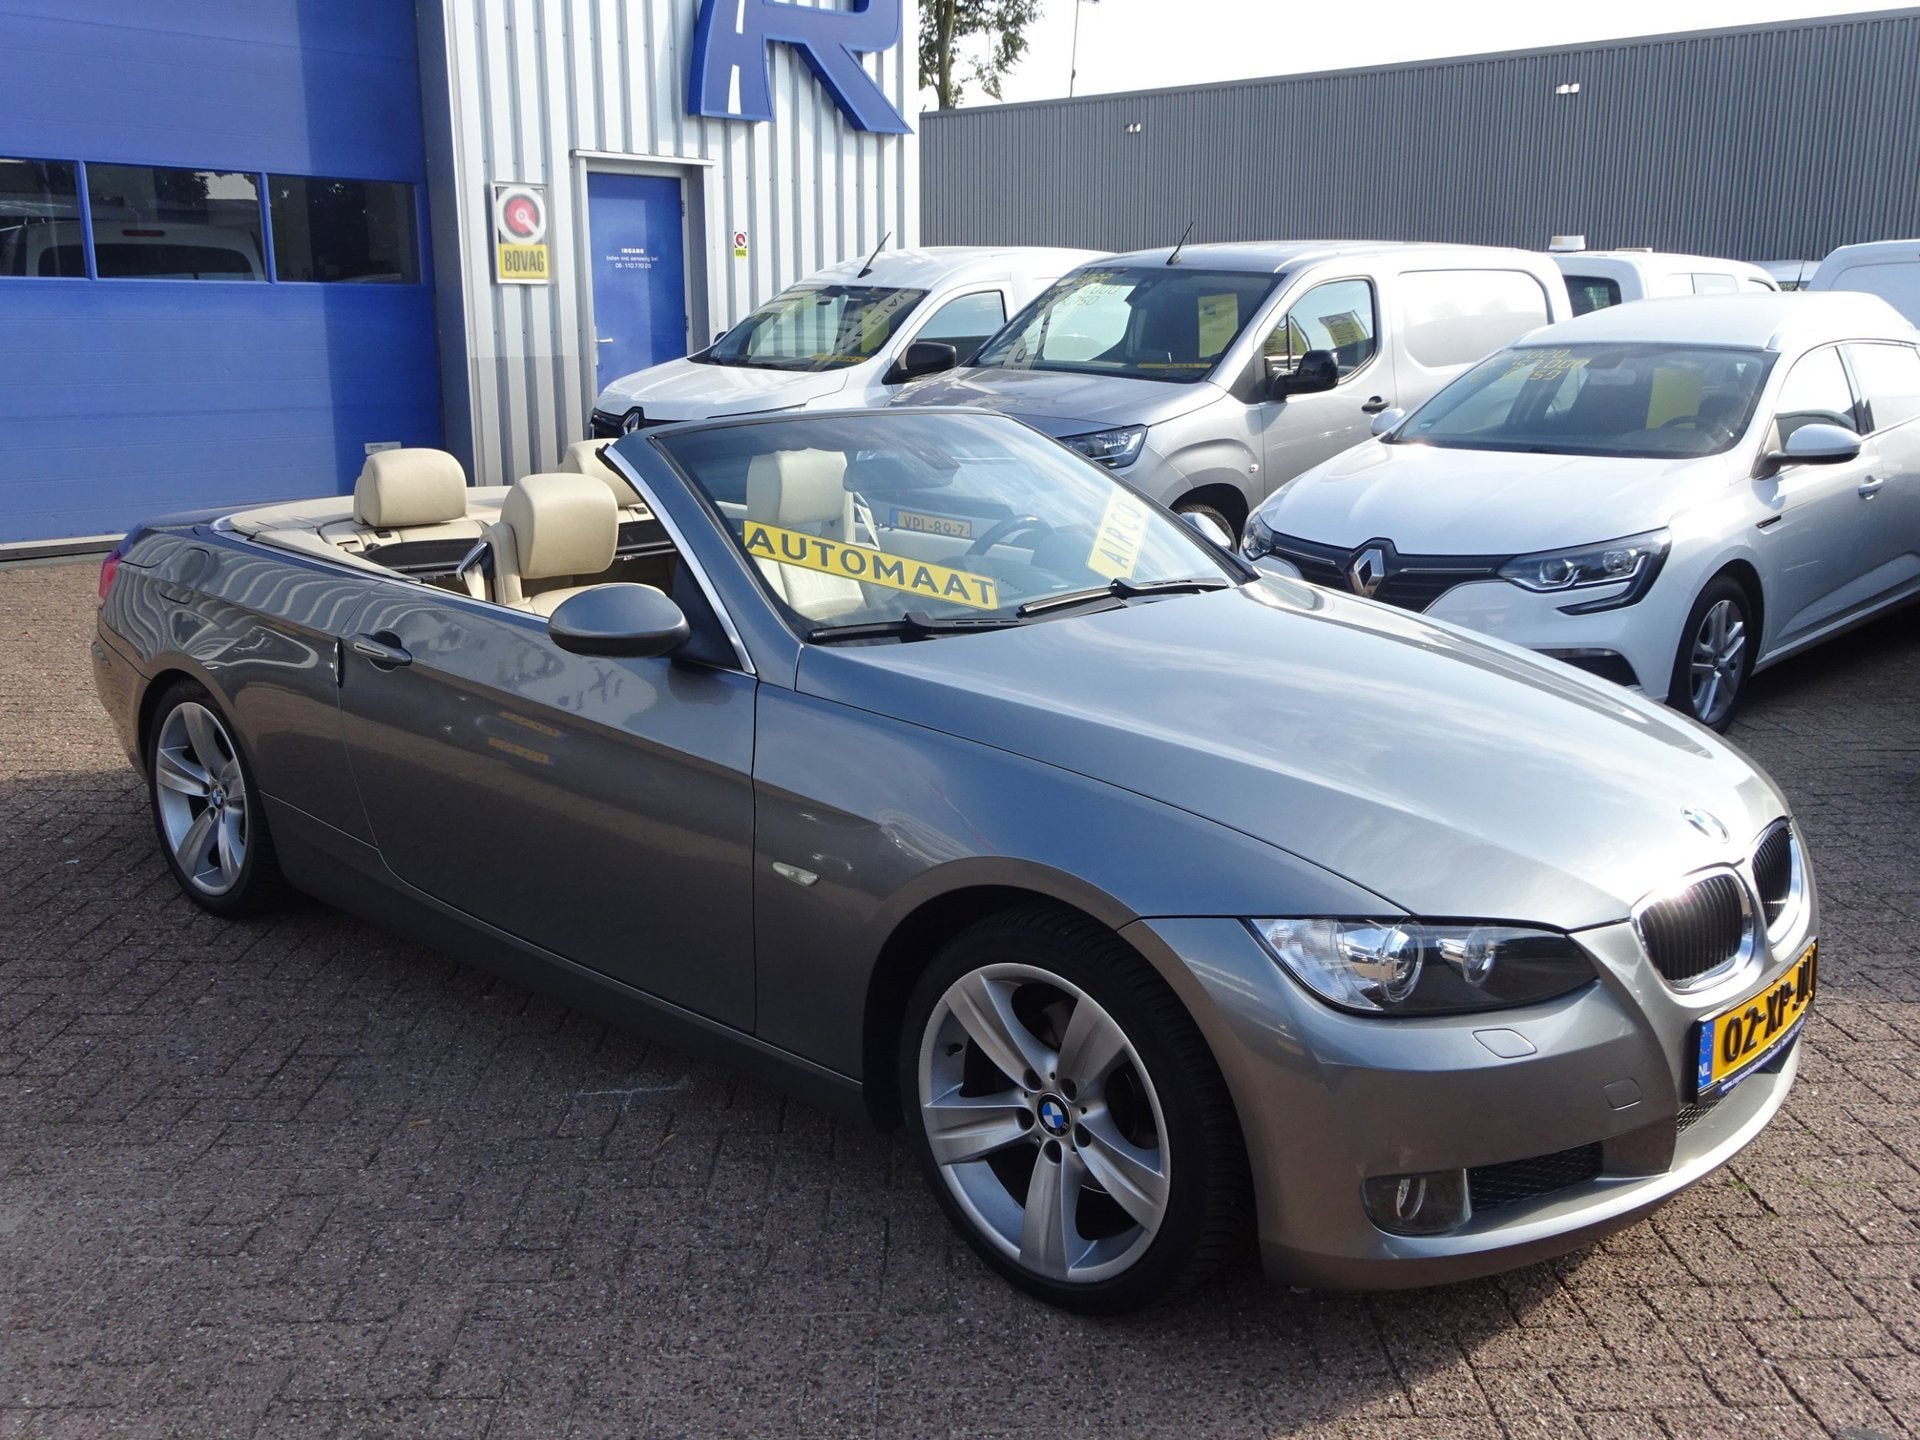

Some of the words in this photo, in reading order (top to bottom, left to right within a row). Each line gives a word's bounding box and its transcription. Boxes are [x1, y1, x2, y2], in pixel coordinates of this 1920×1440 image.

[503, 249, 545, 274] BOVAG
[1098, 502, 1143, 570] AIRCO
[745, 525, 995, 607] AUTOMAAT
[1698, 1064, 1709, 1079] NL
